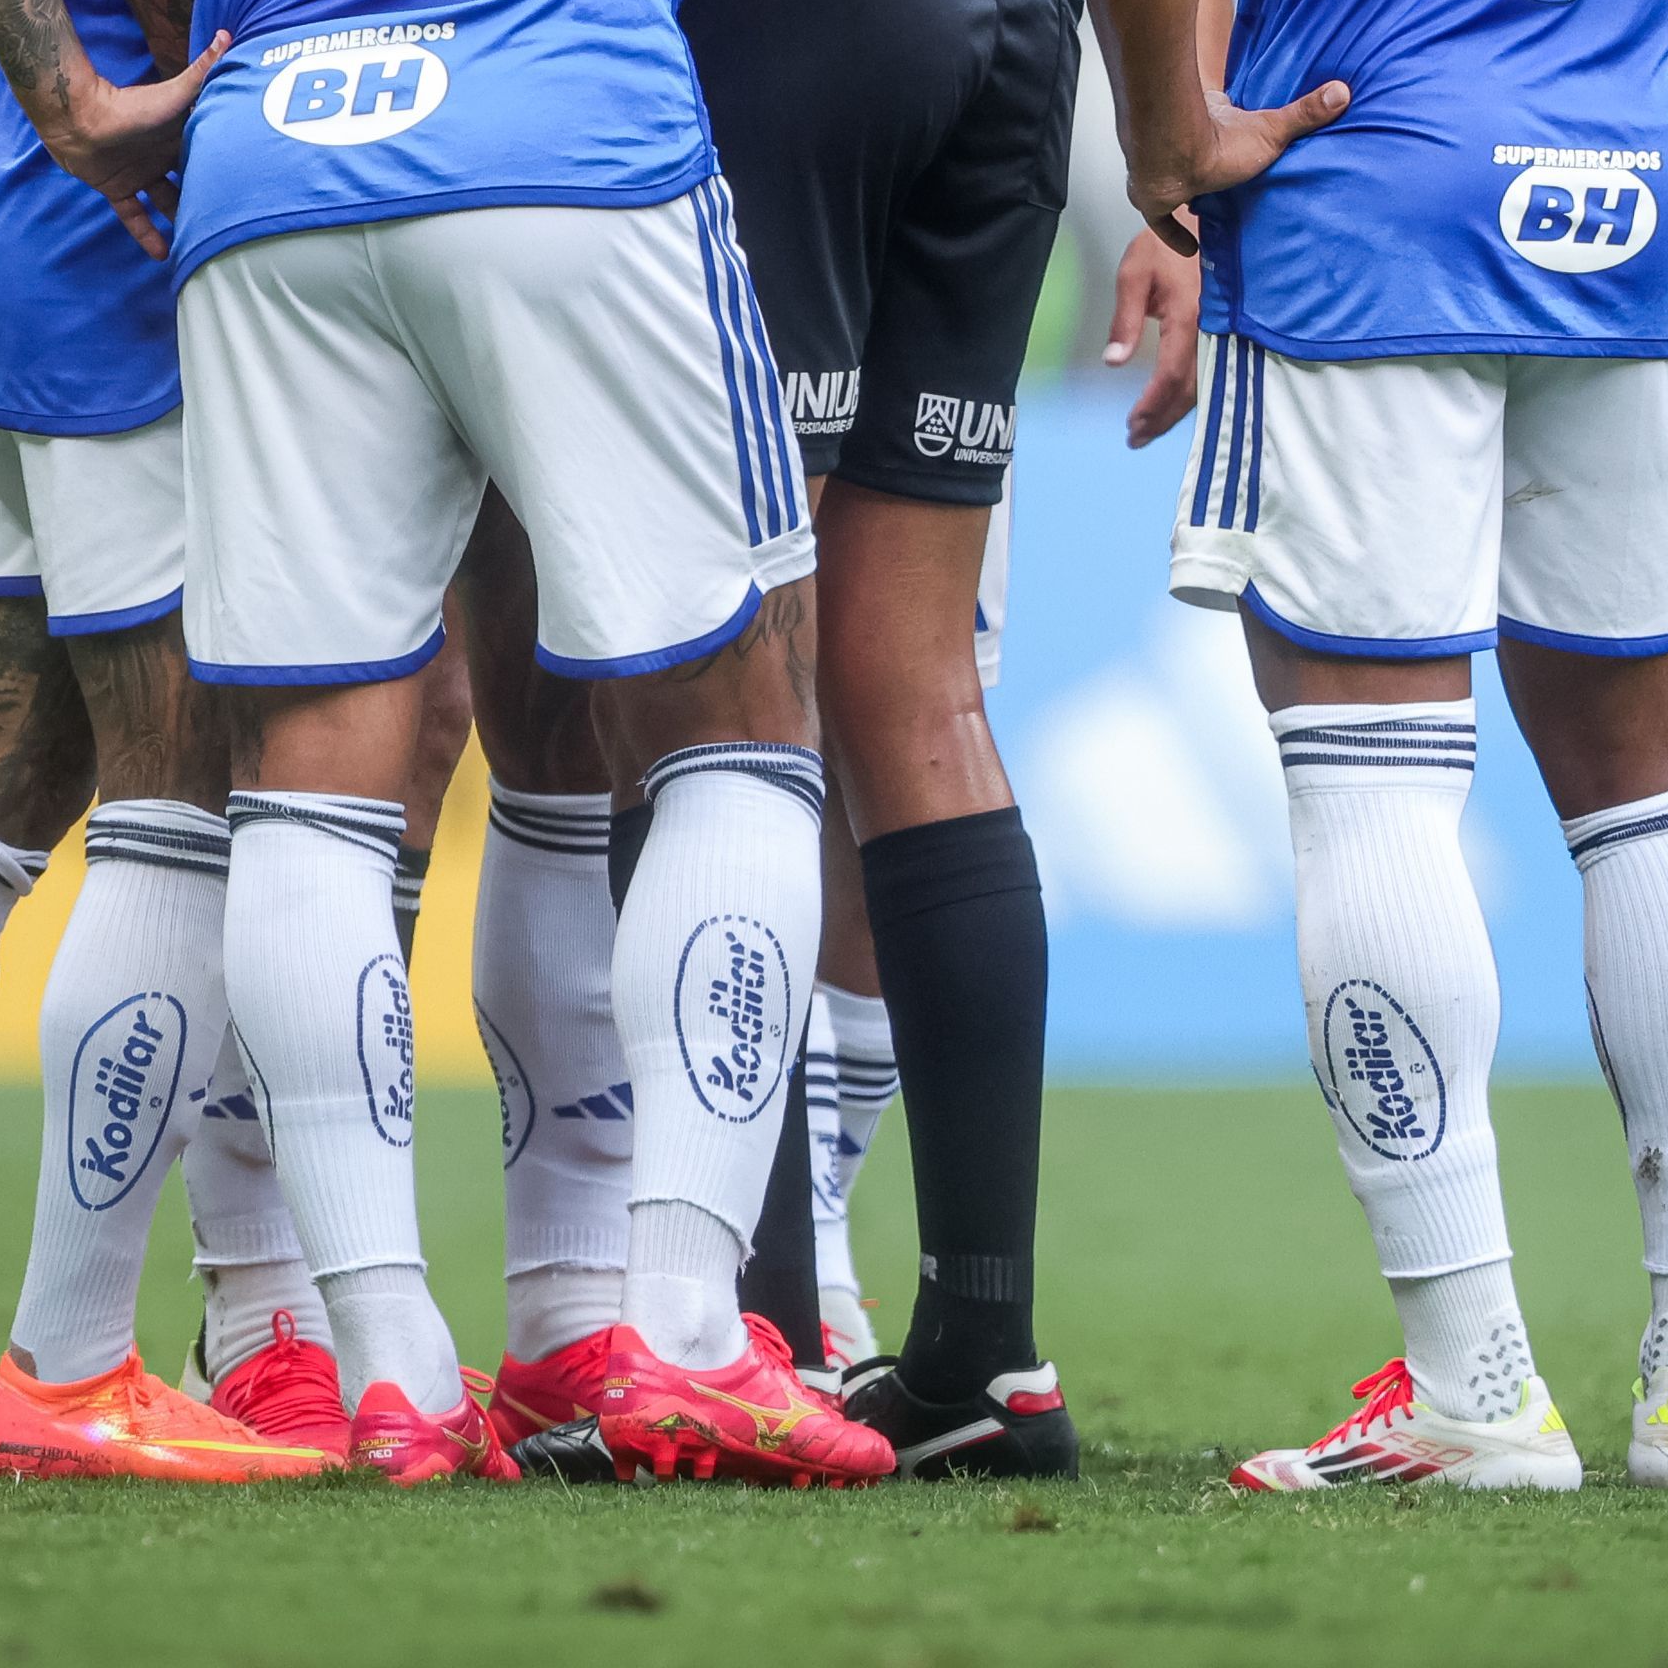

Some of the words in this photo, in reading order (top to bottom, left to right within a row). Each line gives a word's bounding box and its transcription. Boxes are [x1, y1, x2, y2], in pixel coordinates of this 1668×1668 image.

[260, 22, 456, 67] SUPERMERCADOS
[283, 57, 426, 125] BH
[1493, 145, 1663, 171] SUPERMERCADOS
[1516, 184, 1640, 246] BH
[707, 931, 765, 1102] Kodilar
[80, 1010, 163, 1182] Kodilar
[1345, 997, 1426, 1139] Kodilar
